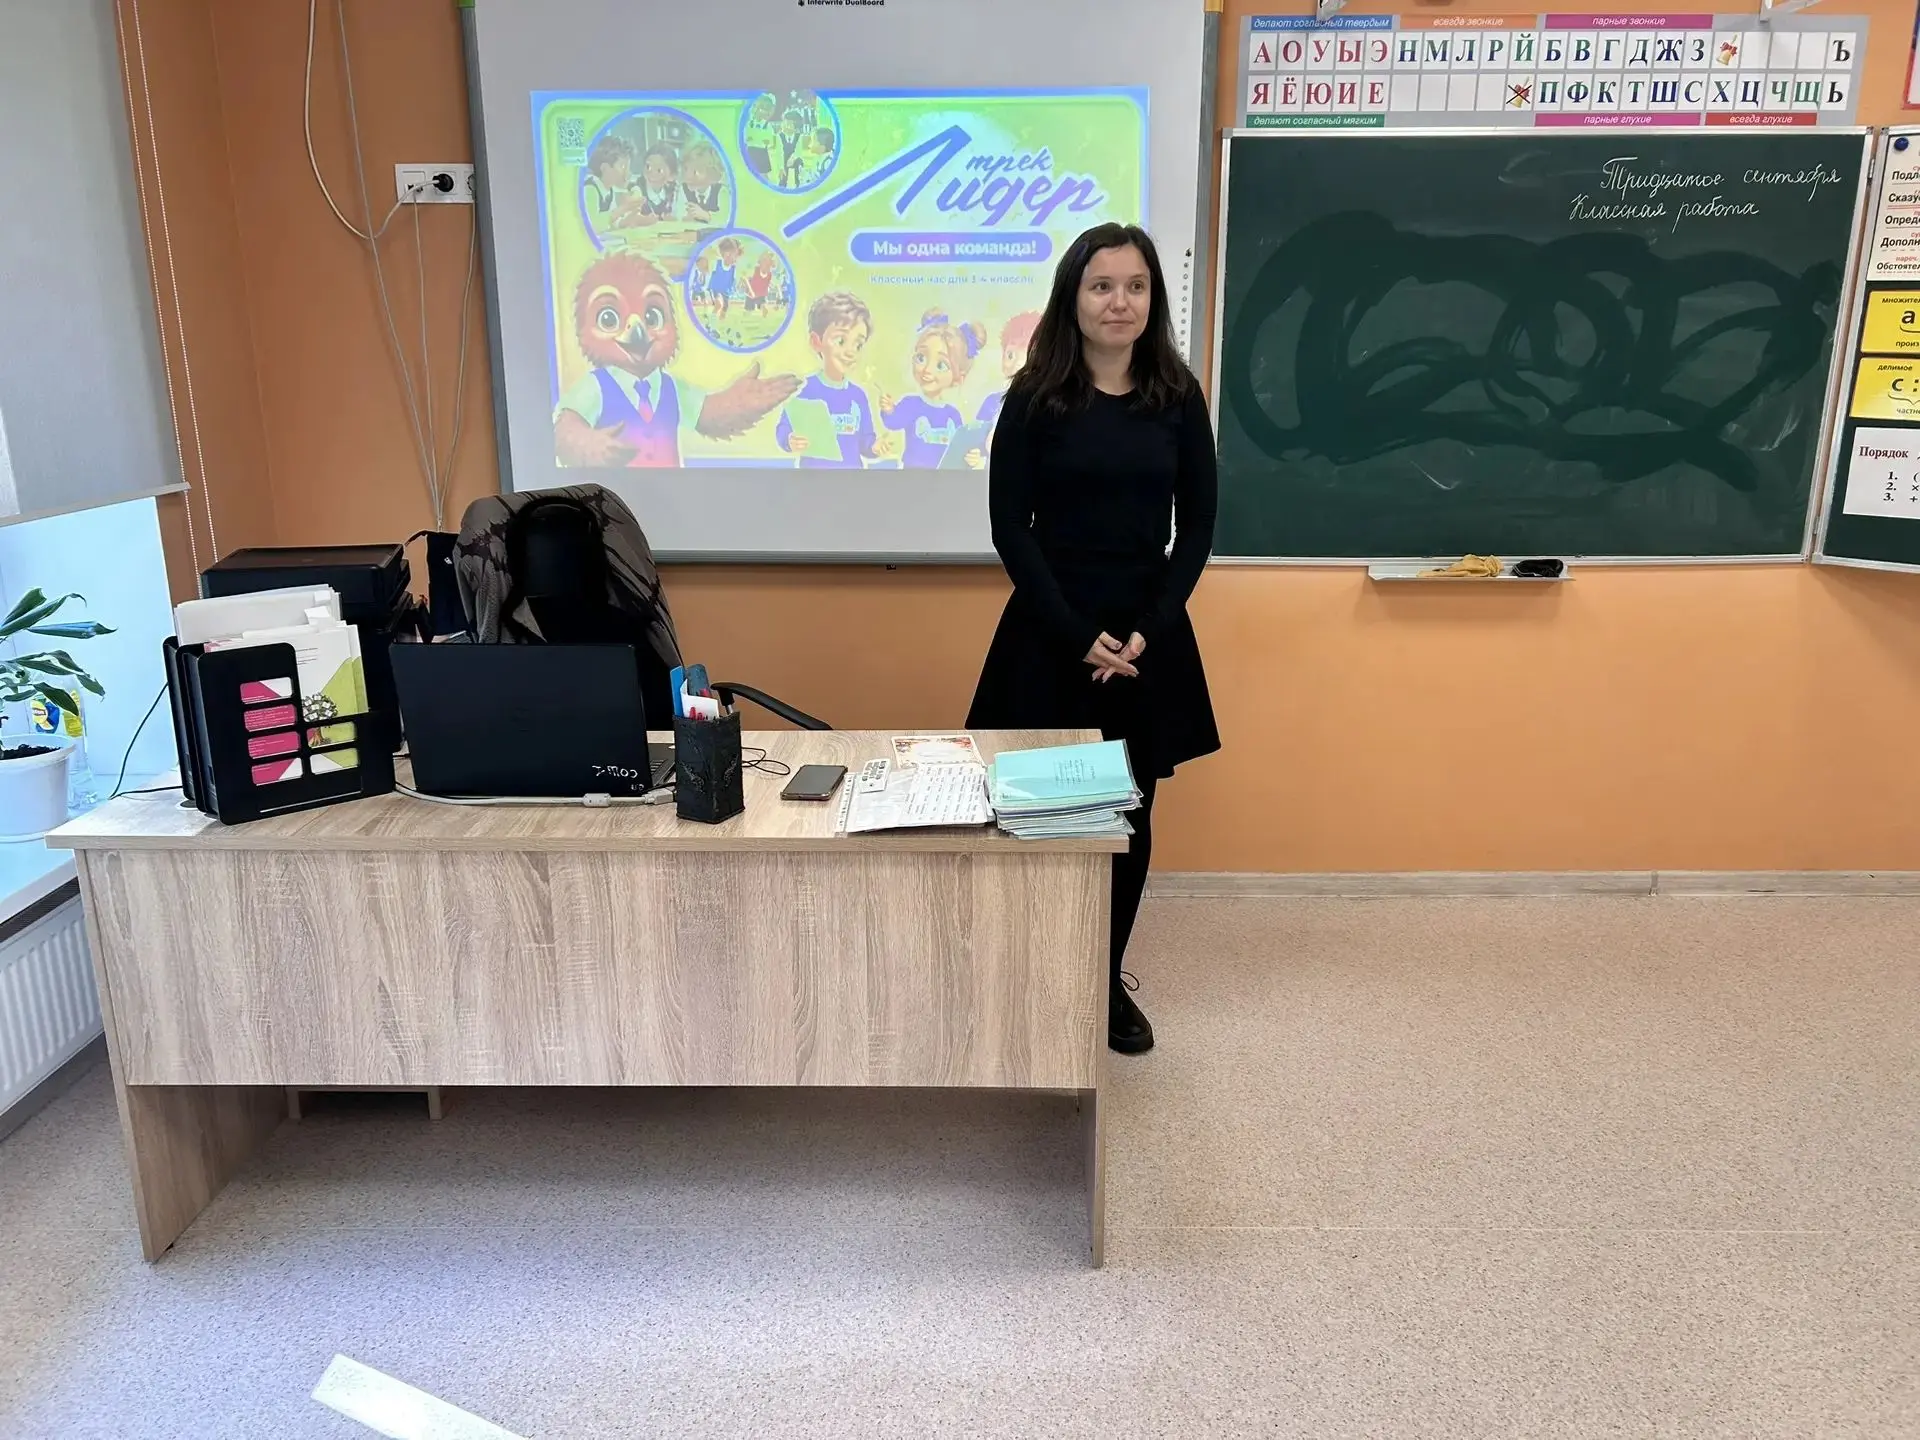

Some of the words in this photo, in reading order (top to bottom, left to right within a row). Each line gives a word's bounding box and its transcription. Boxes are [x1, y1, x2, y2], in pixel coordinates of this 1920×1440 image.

[1254, 18, 1291, 28] делают
[1294, 17, 1343, 28] согласный
[1345, 18, 1389, 27] твердым
[1433, 16, 1464, 26] всегда
[1466, 18, 1503, 26] звонкие
[1592, 17, 1627, 26] парные
[1629, 17, 1665, 25] звонкие
[1253, 41, 1272, 63] А
[1282, 40, 1302, 63] О
[1312, 40, 1331, 62] У
[1339, 40, 1362, 62] Ы
[1371, 40, 1388, 62] Э
[1398, 40, 1420, 62] Н
[1425, 40, 1450, 62] М
[1455, 40, 1476, 62] Л
[1487, 39, 1503, 61] Р
[1514, 33, 1534, 61] Й
[1544, 40, 1561, 61] Б
[1573, 40, 1590, 61] В
[1603, 40, 1620, 61] Г
[1629, 40, 1649, 66] Д
[1656, 40, 1682, 61] Ж
[1690, 39, 1704, 61] З
[1833, 40, 1850, 62] Ъ
[1251, 83, 1269, 104] Я
[1282, 77, 1297, 104] Ё
[1306, 83, 1332, 104] Ю
[1338, 83, 1360, 103] И
[1368, 82, 1384, 103] Е
[1538, 82, 1559, 103] П
[1567, 82, 1588, 103] Ф
[1596, 82, 1616, 103] К
[1628, 82, 1646, 102] Т
[1650, 81, 1679, 102] Ш
[1684, 81, 1703, 102] С
[1711, 81, 1731, 102] Х
[1741, 81, 1760, 107] Ц
[1771, 81, 1788, 102] Ч
[1793, 81, 1820, 108] Щ
[1827, 82, 1843, 102] Ь
[1254, 116, 1290, 125] делают
[1293, 114, 1341, 125] согласный
[1343, 116, 1376, 124] мягким
[1584, 115, 1618, 124] парные
[1620, 115, 1652, 124] глухие
[1729, 114, 1761, 123] всегда
[1763, 114, 1793, 124] глухие
[966, 148, 1052, 182] трек
[783, 124, 1104, 238] Лидер
[1600, 156, 1724, 200] Тридцатое
[1743, 163, 1842, 202] сентября
[1892, 171, 1920, 180] Подл
[1569, 193, 1667, 220] Классная
[1672, 196, 1759, 233] работа
[873, 240, 902, 255] Мы
[907, 243, 950, 256] одна
[954, 240, 1037, 256] команда!
[1859, 446, 1909, 459] Порядок
[1888, 471, 1898, 480] 1.
[1885, 482, 1897, 491] 2.
[1883, 493, 1895, 501] 3.
